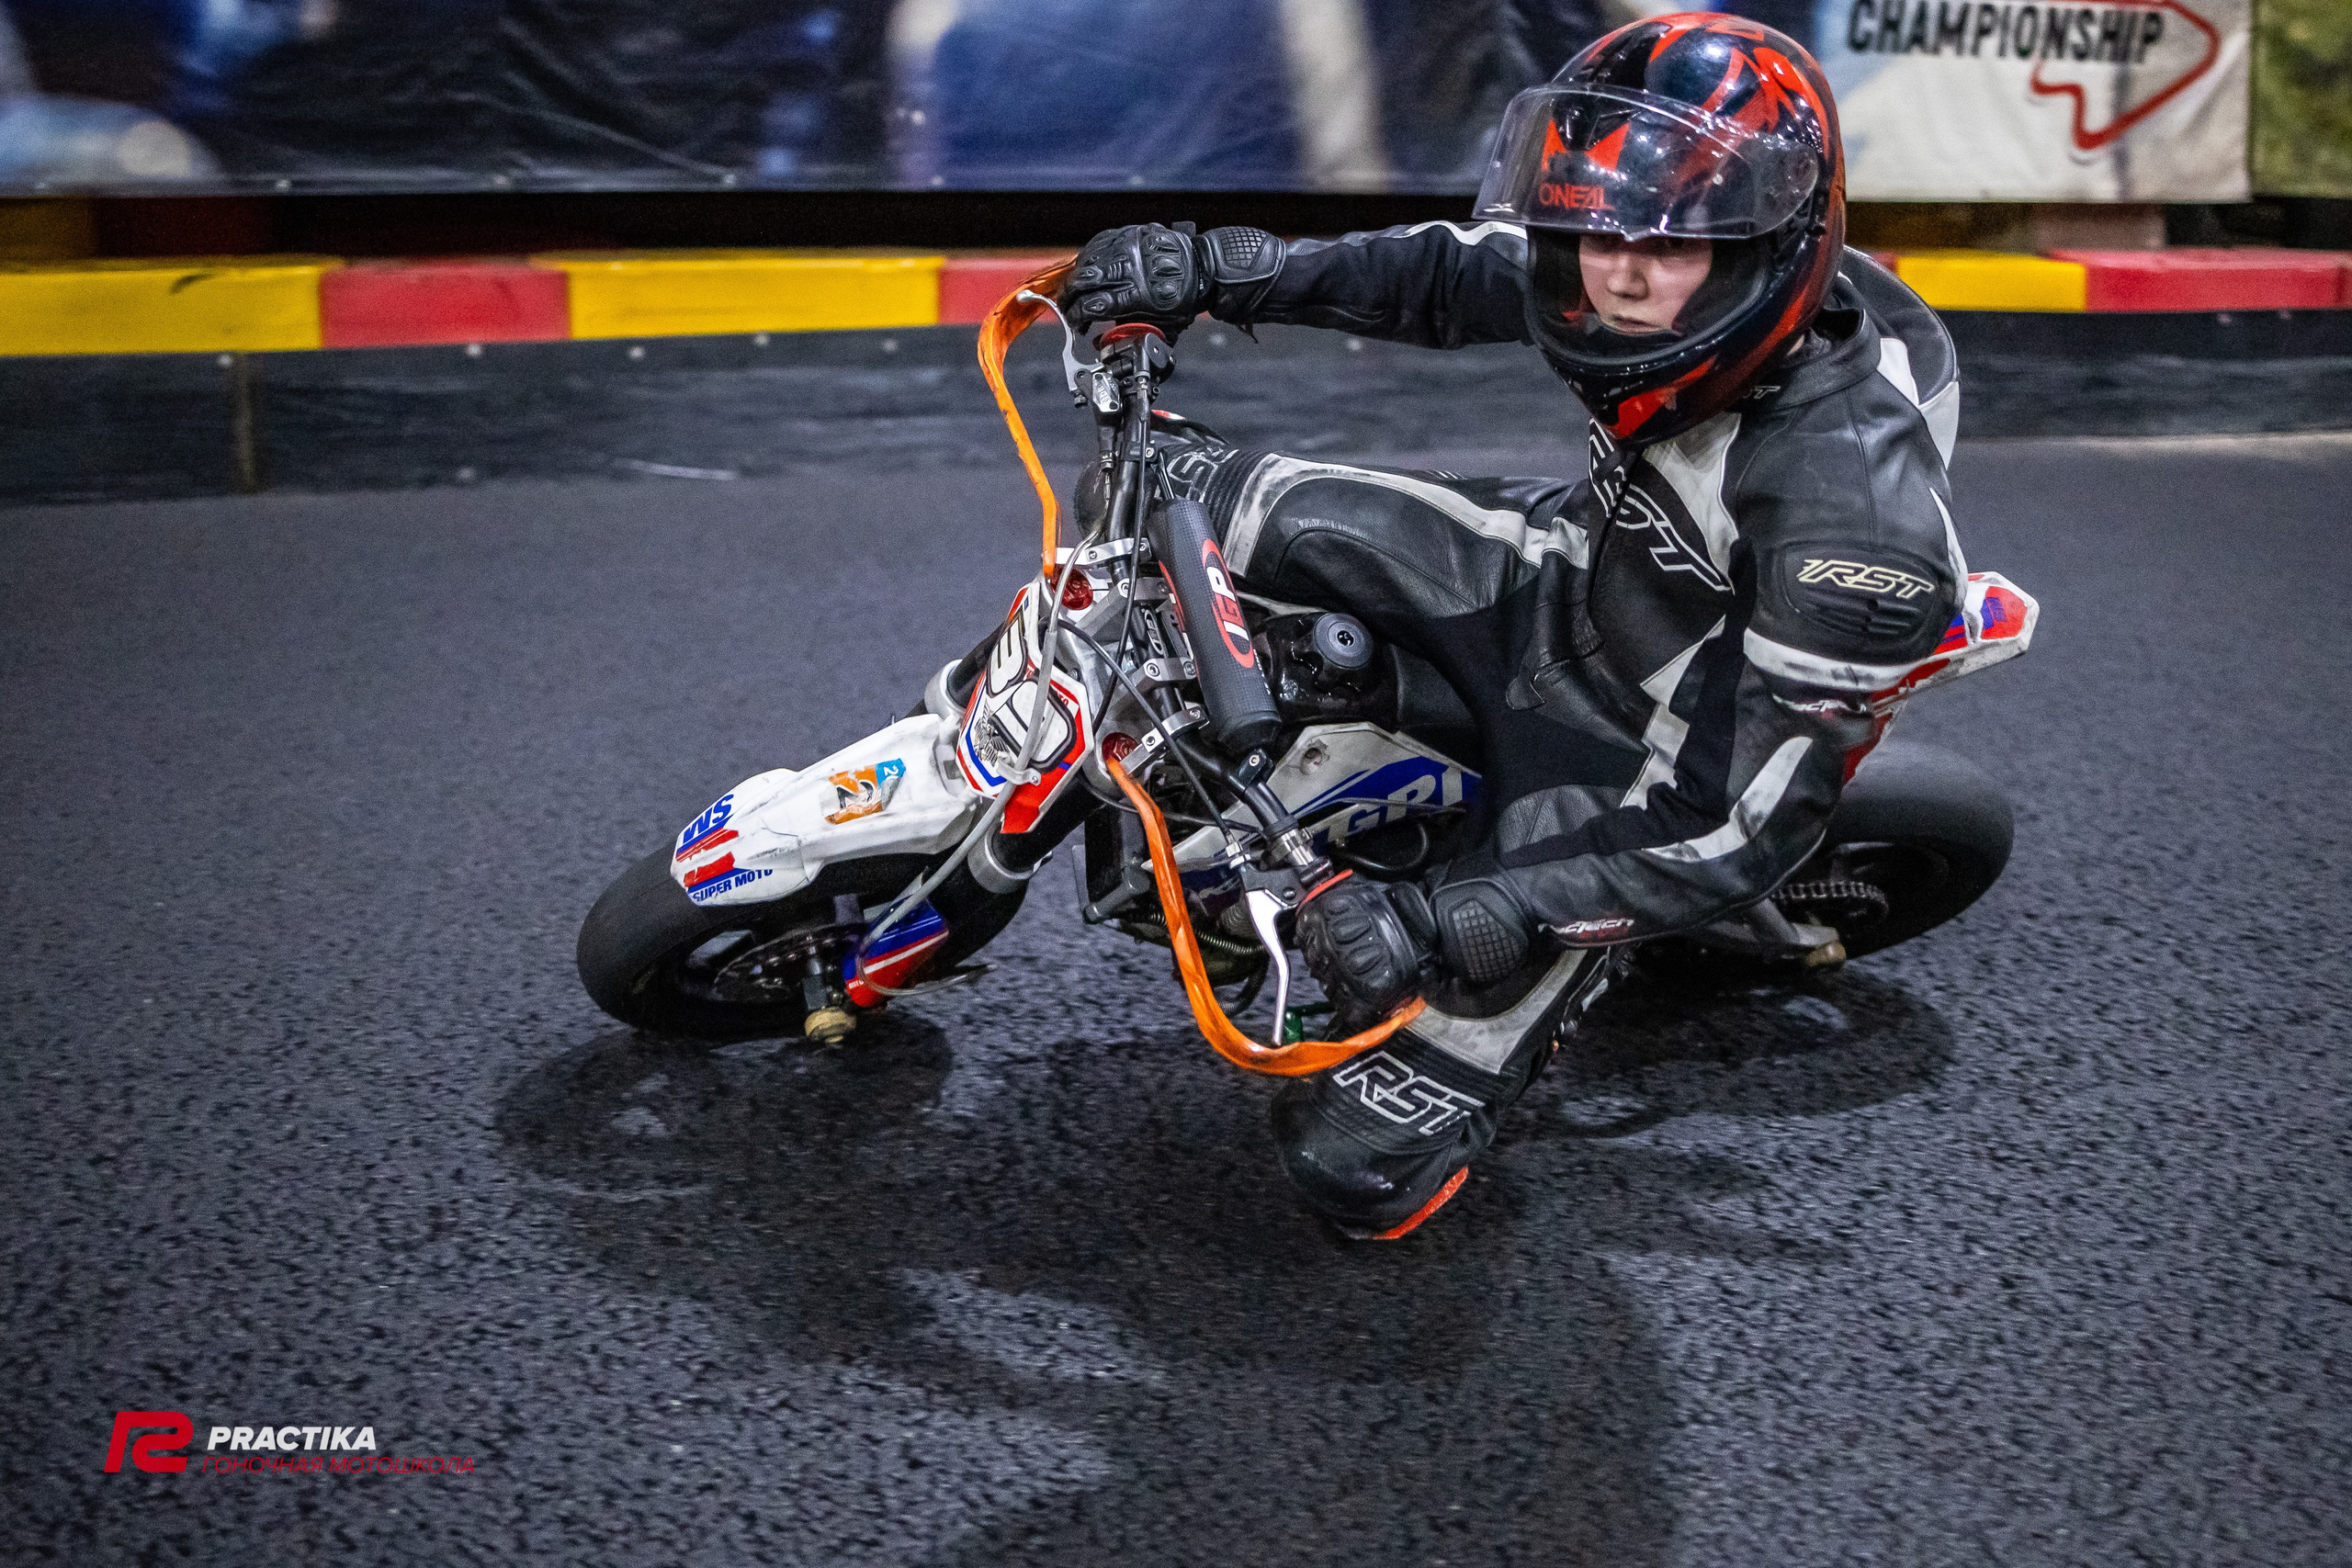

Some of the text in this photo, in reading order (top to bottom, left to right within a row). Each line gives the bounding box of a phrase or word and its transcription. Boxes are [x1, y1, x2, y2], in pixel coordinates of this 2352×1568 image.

[1849, 0, 2165, 63] CHAMPIONSHIP
[692, 879, 732, 902] SUPER
[1332, 1050, 1486, 1136] RST
